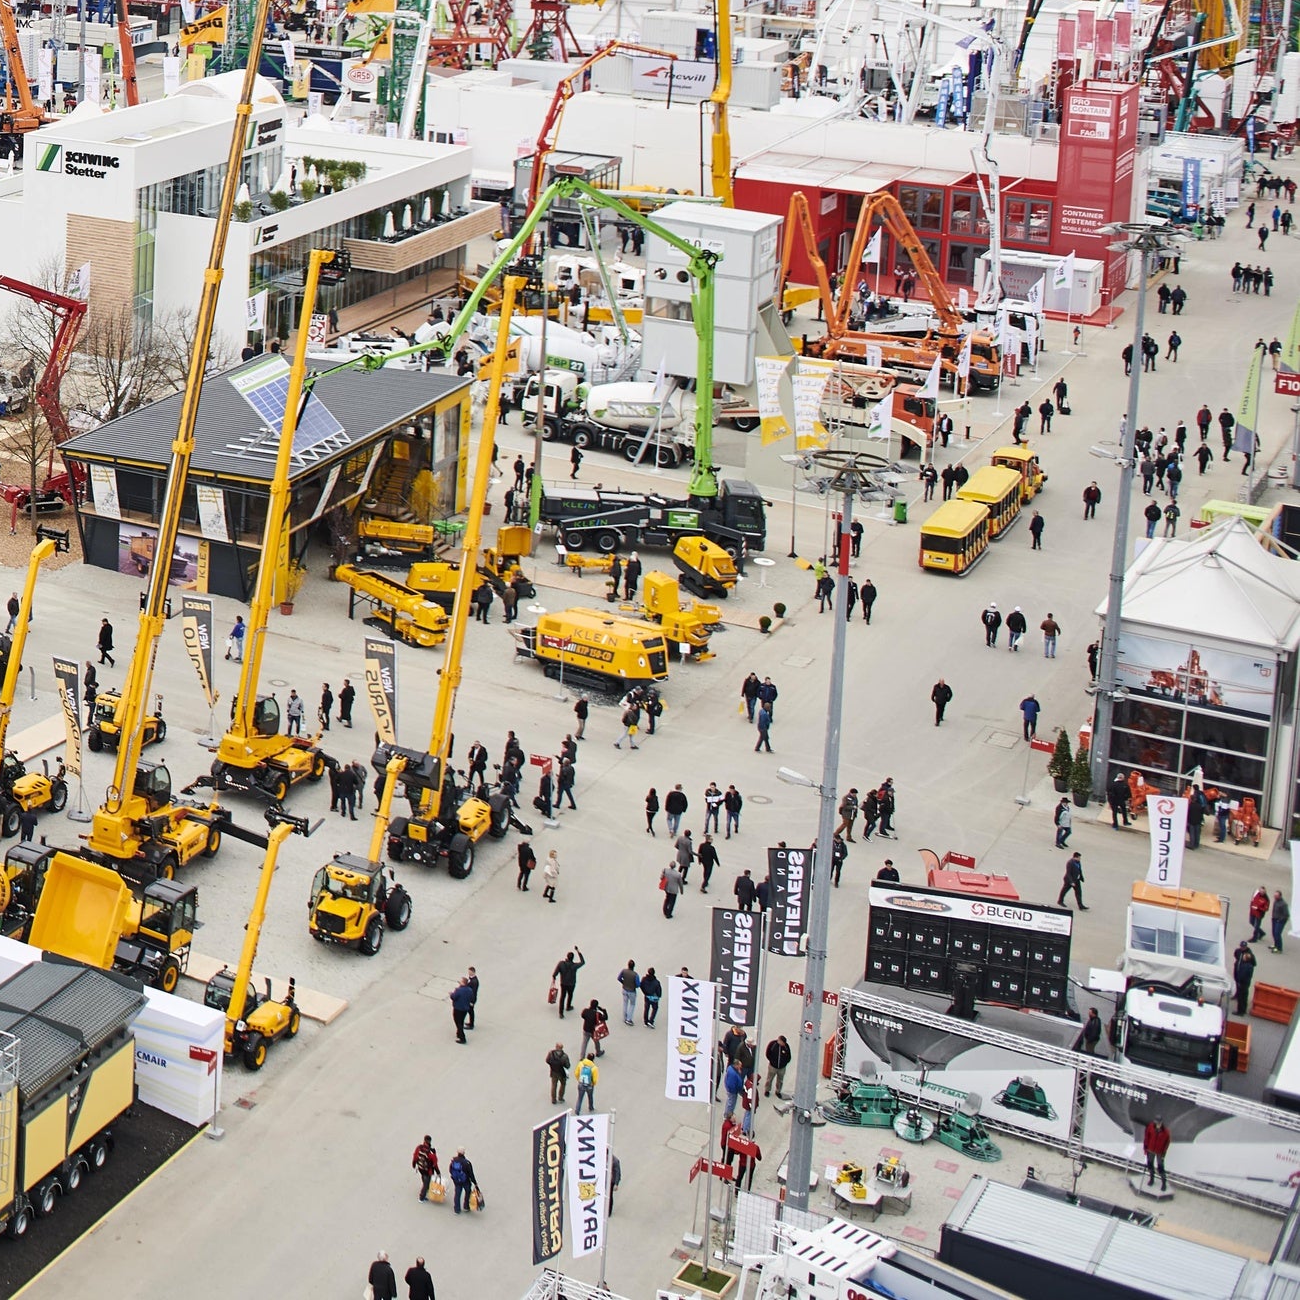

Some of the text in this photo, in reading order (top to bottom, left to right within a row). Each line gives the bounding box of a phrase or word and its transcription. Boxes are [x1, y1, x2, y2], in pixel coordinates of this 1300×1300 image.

[1073, 98, 1090, 106] PRO
[1071, 105, 1107, 116] CONTAIN
[65, 150, 119, 168] SCHWING
[65, 163, 106, 179] Stetter
[1062, 209, 1104, 220] CONTAINER
[569, 361, 583, 372] 27
[562, 500, 595, 510] KLEIN
[573, 518, 608, 528] KLEIN
[199, 540, 209, 579] KLEIN
[573, 629, 618, 648] KLEIN
[986, 905, 1032, 923] BLEND
[863, 1013, 903, 1031] LIEVERS
[1104, 1082, 1148, 1101] LIEVERS
